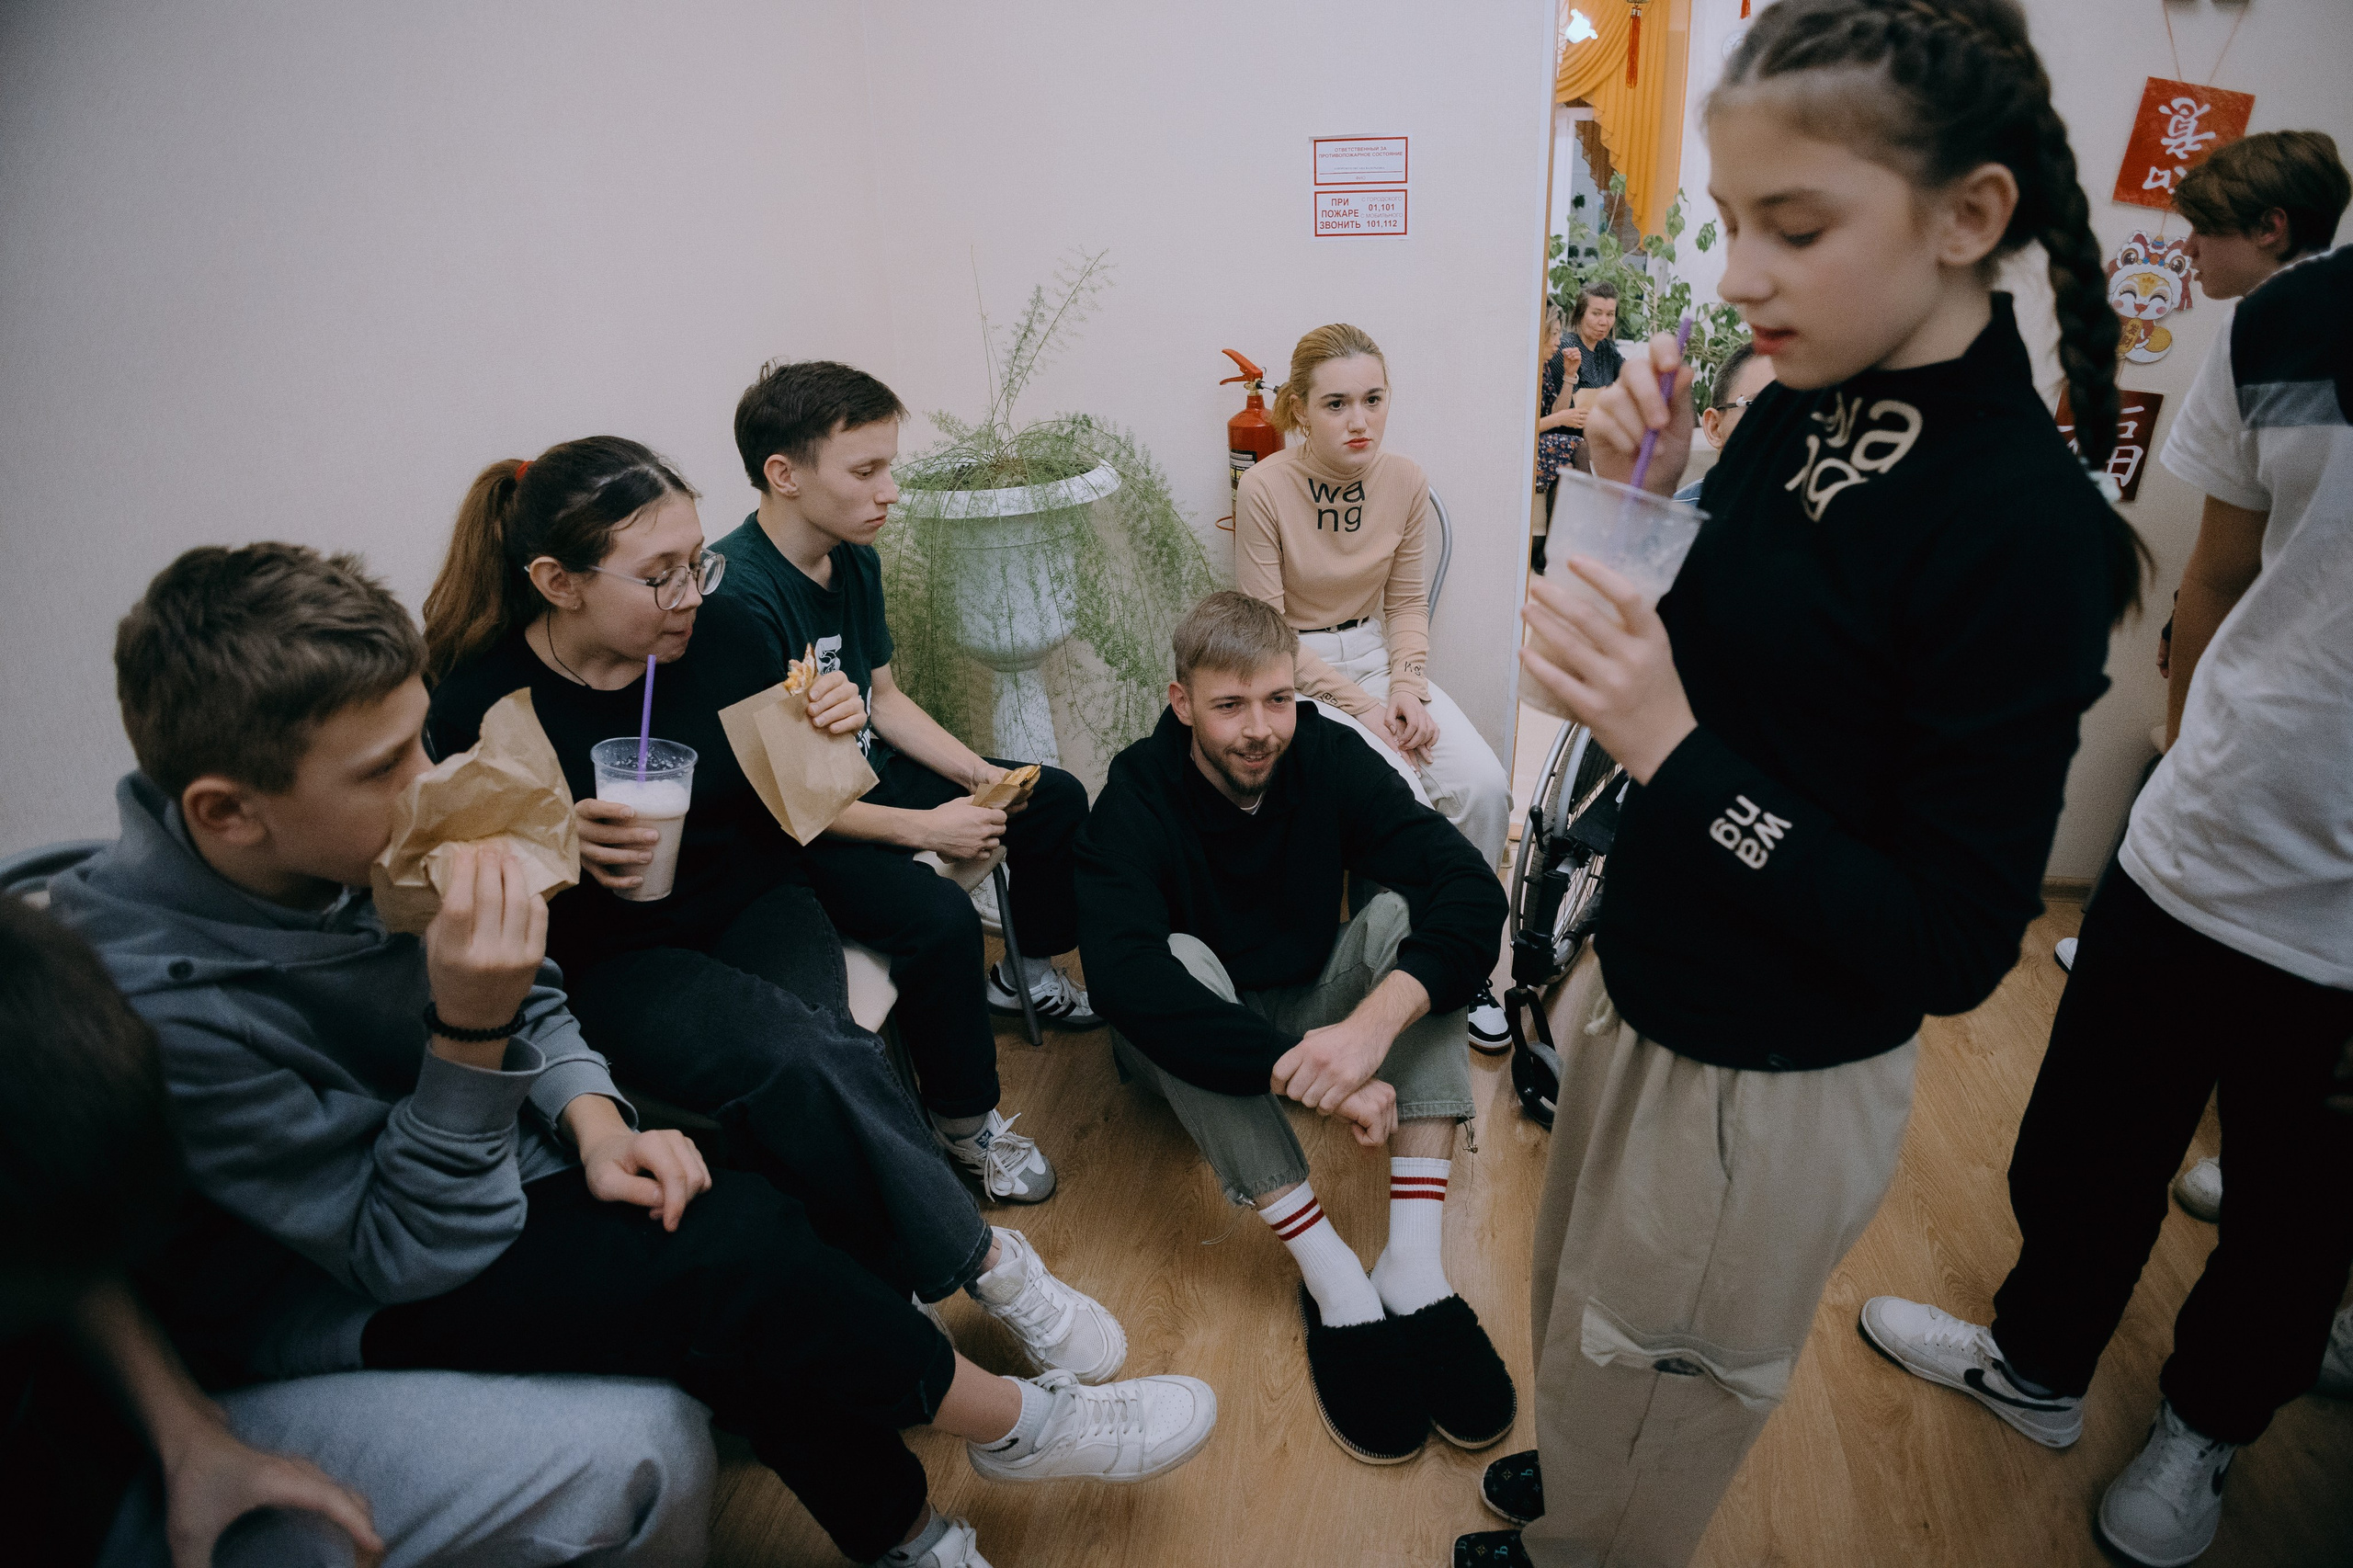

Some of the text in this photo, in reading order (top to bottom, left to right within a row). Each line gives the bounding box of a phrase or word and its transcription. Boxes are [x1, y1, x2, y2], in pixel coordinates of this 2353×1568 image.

[1331, 198, 1349, 207] ПРИ
[1321, 210, 1359, 218] ПОЖАРЕ
[1319, 221, 1361, 230] ЗВОНИТЬ
[1308, 478, 1366, 505] wa
[1317, 505, 1363, 533] ng
